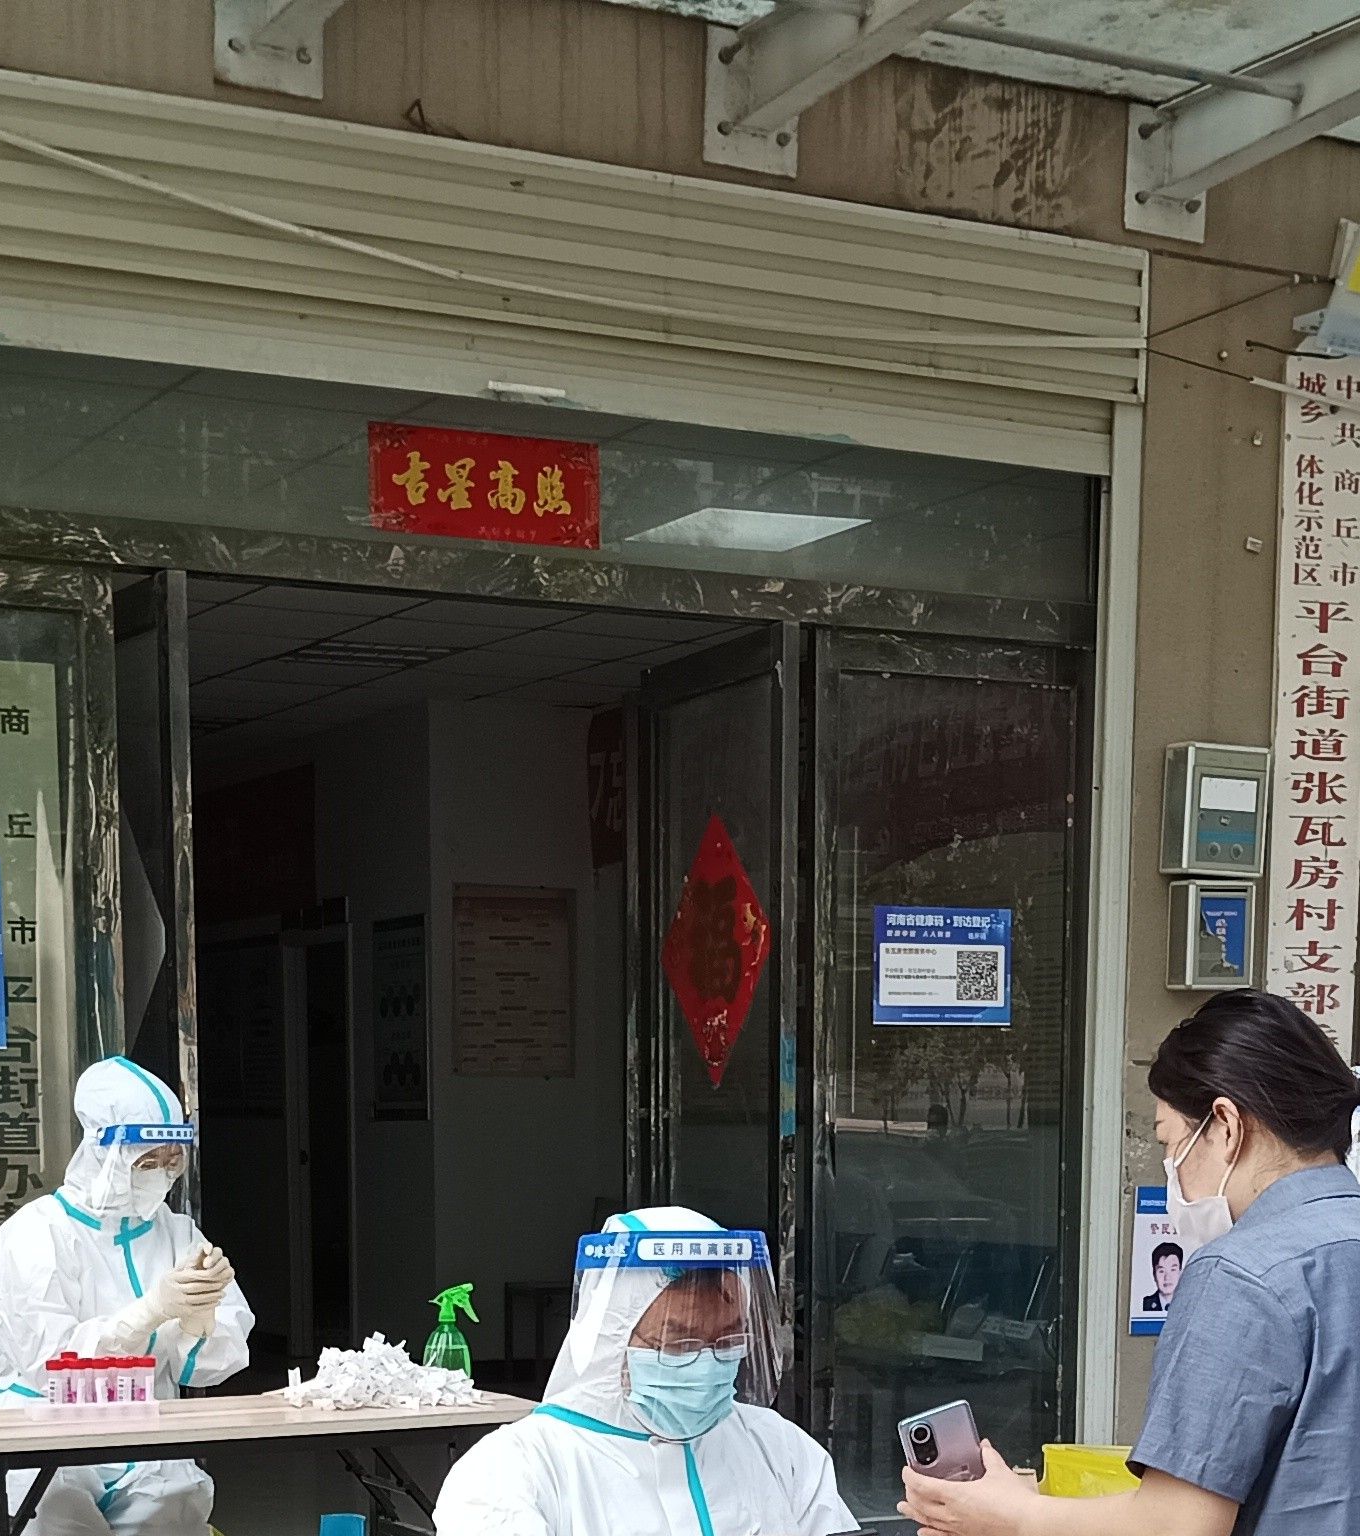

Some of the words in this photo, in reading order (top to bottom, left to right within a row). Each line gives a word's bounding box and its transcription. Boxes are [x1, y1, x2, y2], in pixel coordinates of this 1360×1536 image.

[392, 451, 572, 517] 吉星高照
[1293, 371, 1329, 588] 城乡一体化示范区
